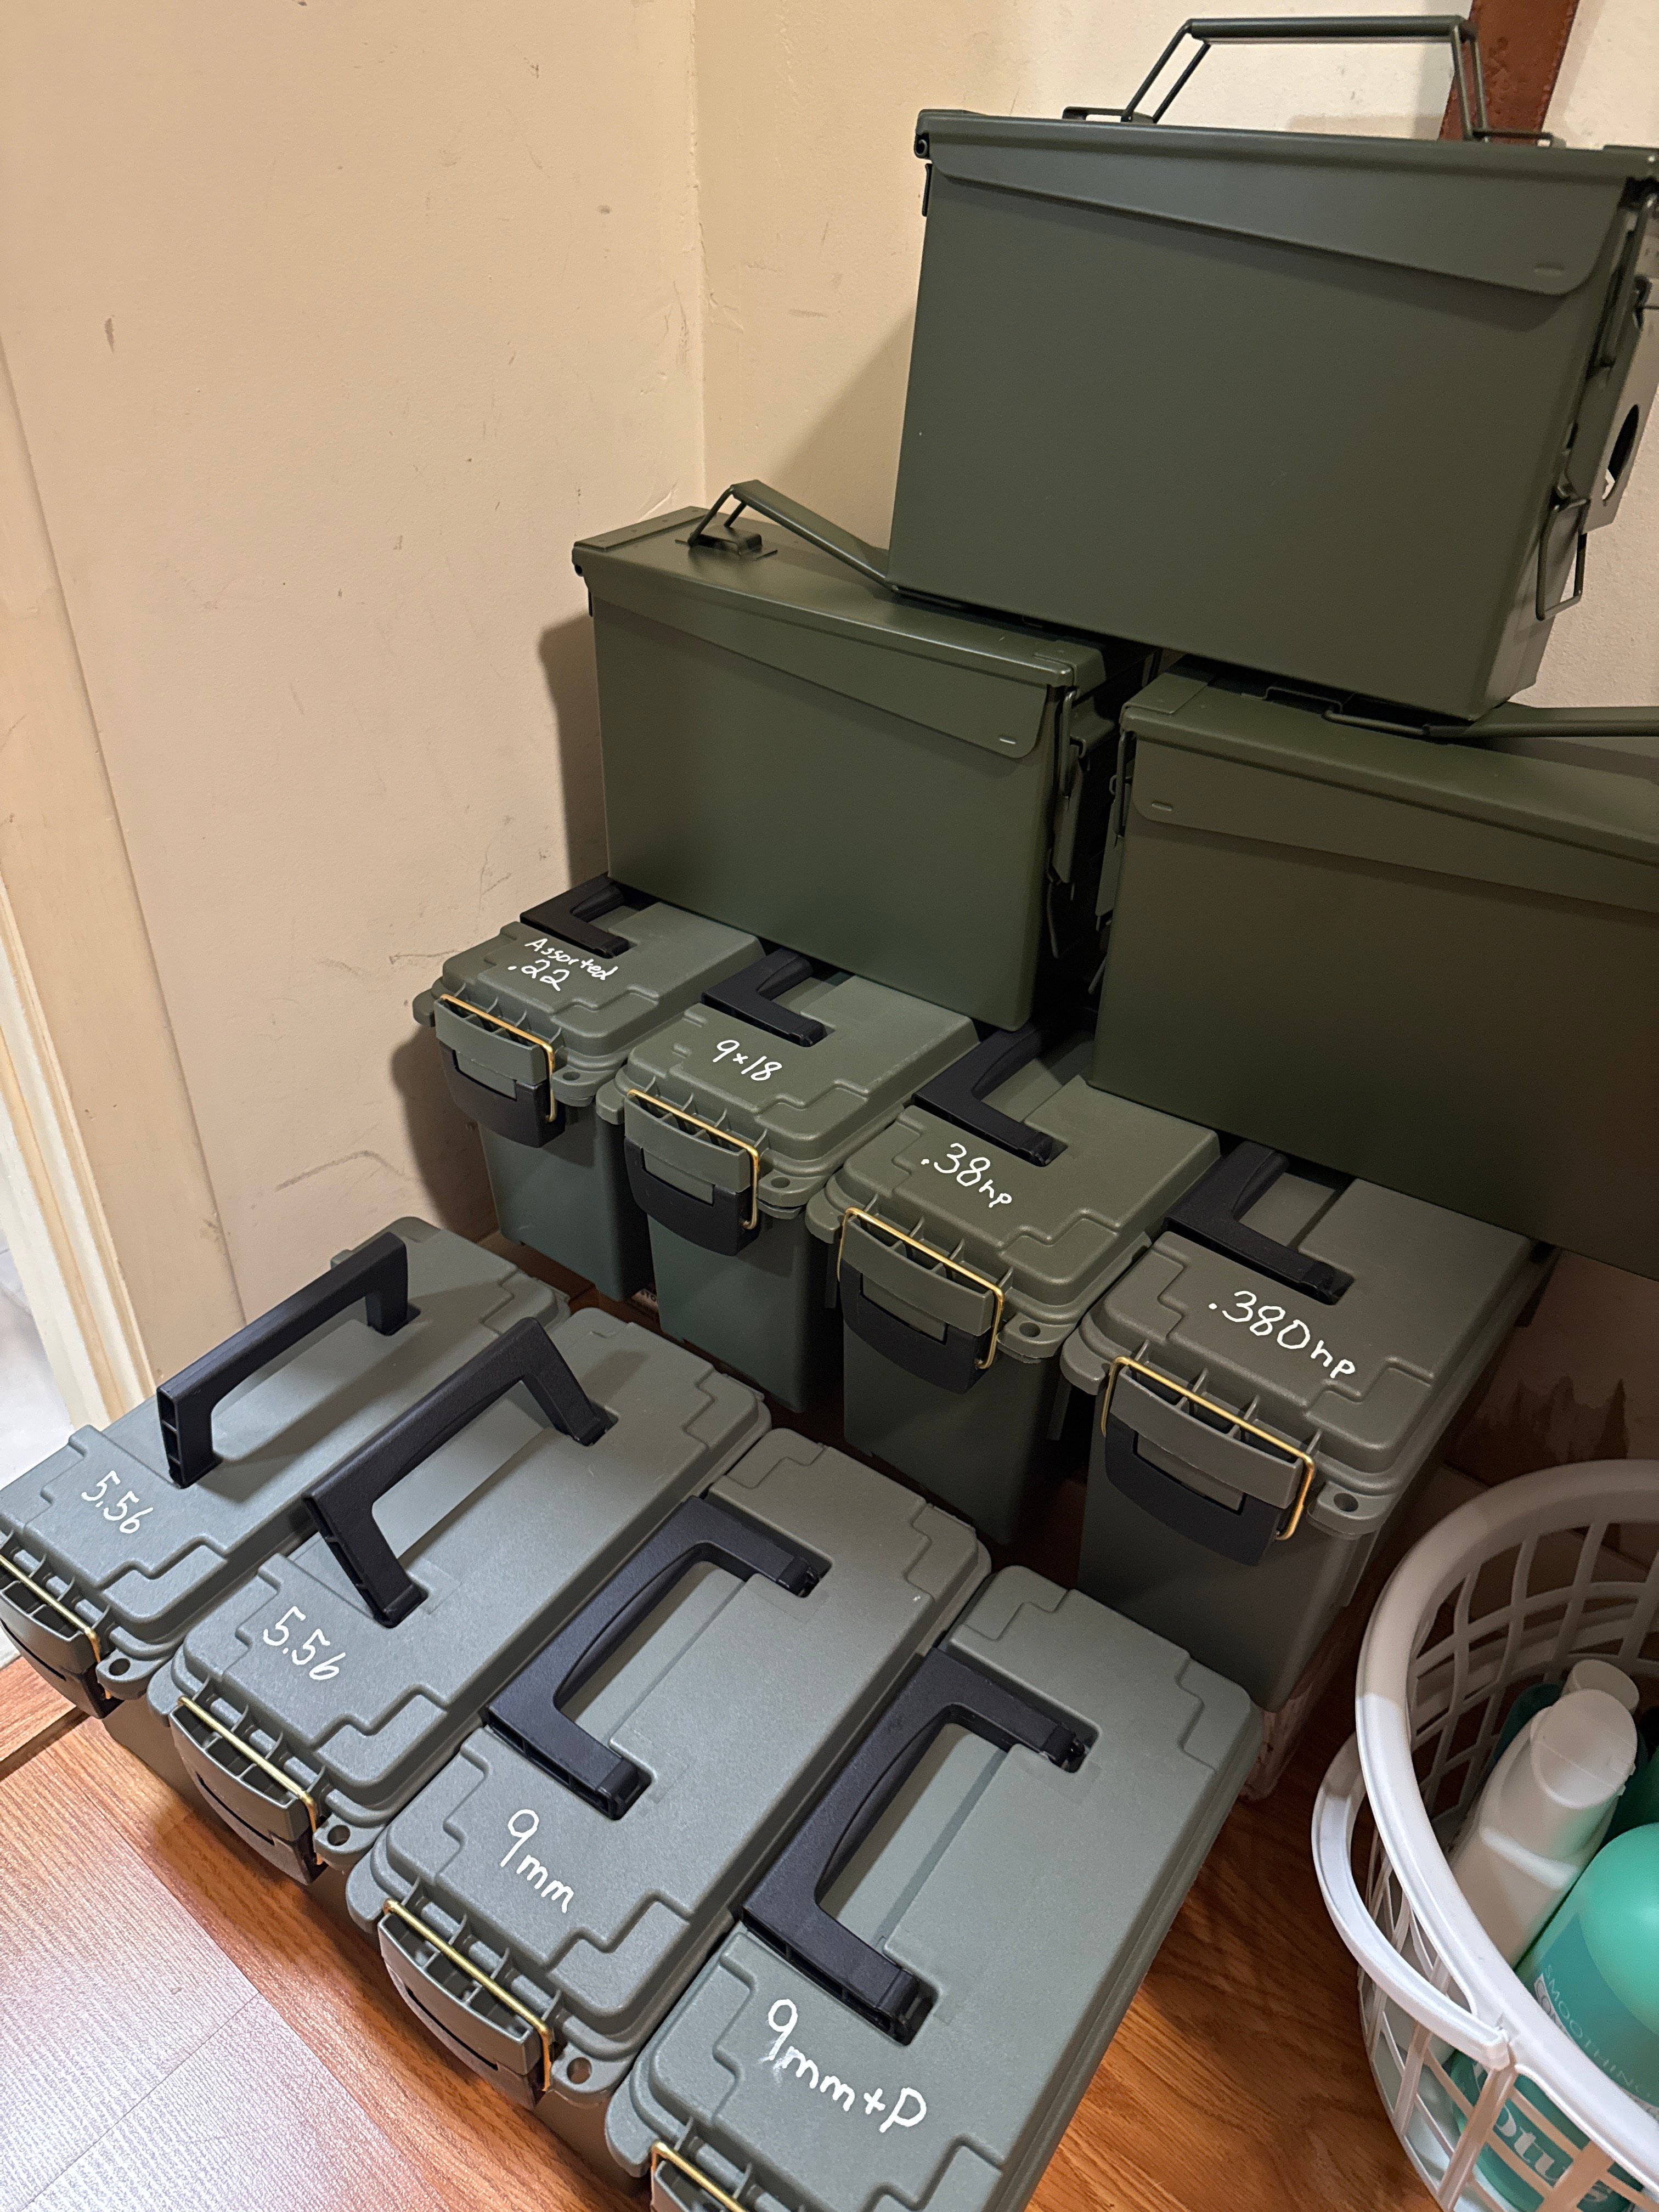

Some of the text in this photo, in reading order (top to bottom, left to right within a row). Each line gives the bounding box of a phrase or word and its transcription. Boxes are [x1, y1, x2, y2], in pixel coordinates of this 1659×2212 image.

[507, 959, 570, 992] .22
[524, 938, 619, 981] Assorted
[81, 1470, 154, 1534] 5.56
[263, 1606, 346, 1680] 5.56
[500, 1809, 574, 1914] 9mm
